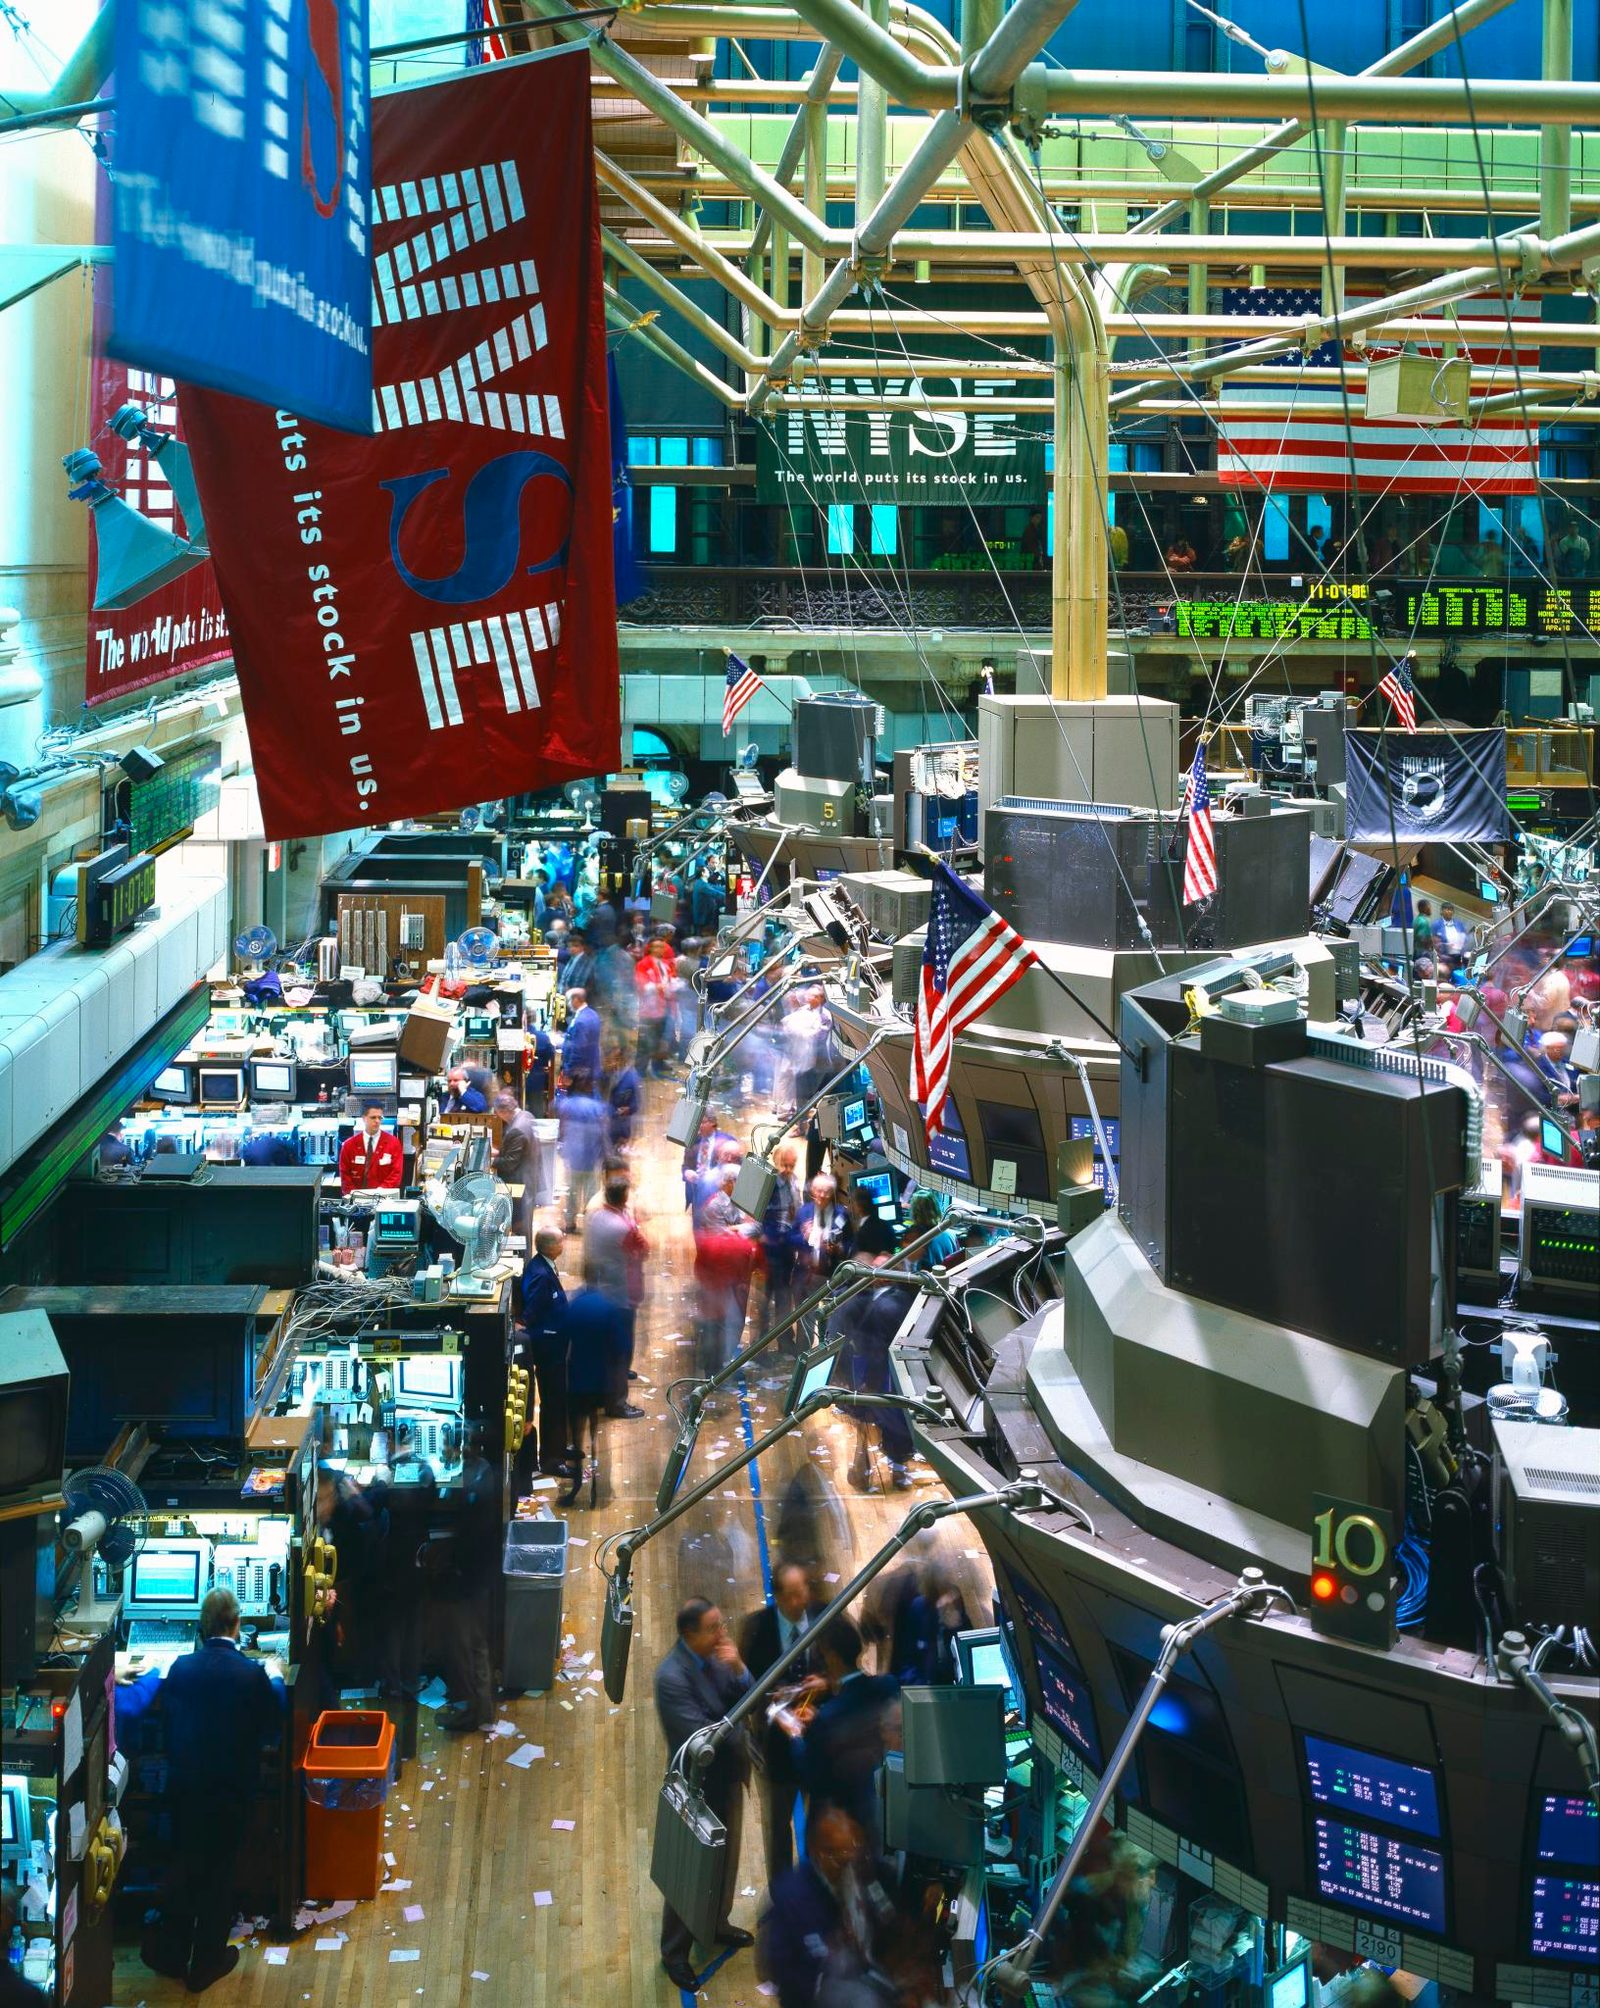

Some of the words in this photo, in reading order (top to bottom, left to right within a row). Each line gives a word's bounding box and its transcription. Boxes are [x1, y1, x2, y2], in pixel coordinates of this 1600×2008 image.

[274, 409, 307, 472] uts
[371, 159, 574, 731] NYSE
[787, 377, 1016, 458] NYSE
[773, 470, 805, 483] The
[813, 470, 857, 483] world
[865, 472, 899, 486] puts
[906, 472, 927, 484] its
[933, 472, 977, 484] stock
[983, 472, 998, 484] in
[1005, 473, 1028, 484] us.
[292, 489, 323, 545] its
[307, 564, 356, 681] stock
[96, 628, 125, 674] The
[335, 696, 365, 736] in
[348, 754, 378, 811] us.
[823, 802, 834, 819] 5
[1313, 1506, 1388, 1577] 10
[1360, 1935, 1396, 1960] 2190
